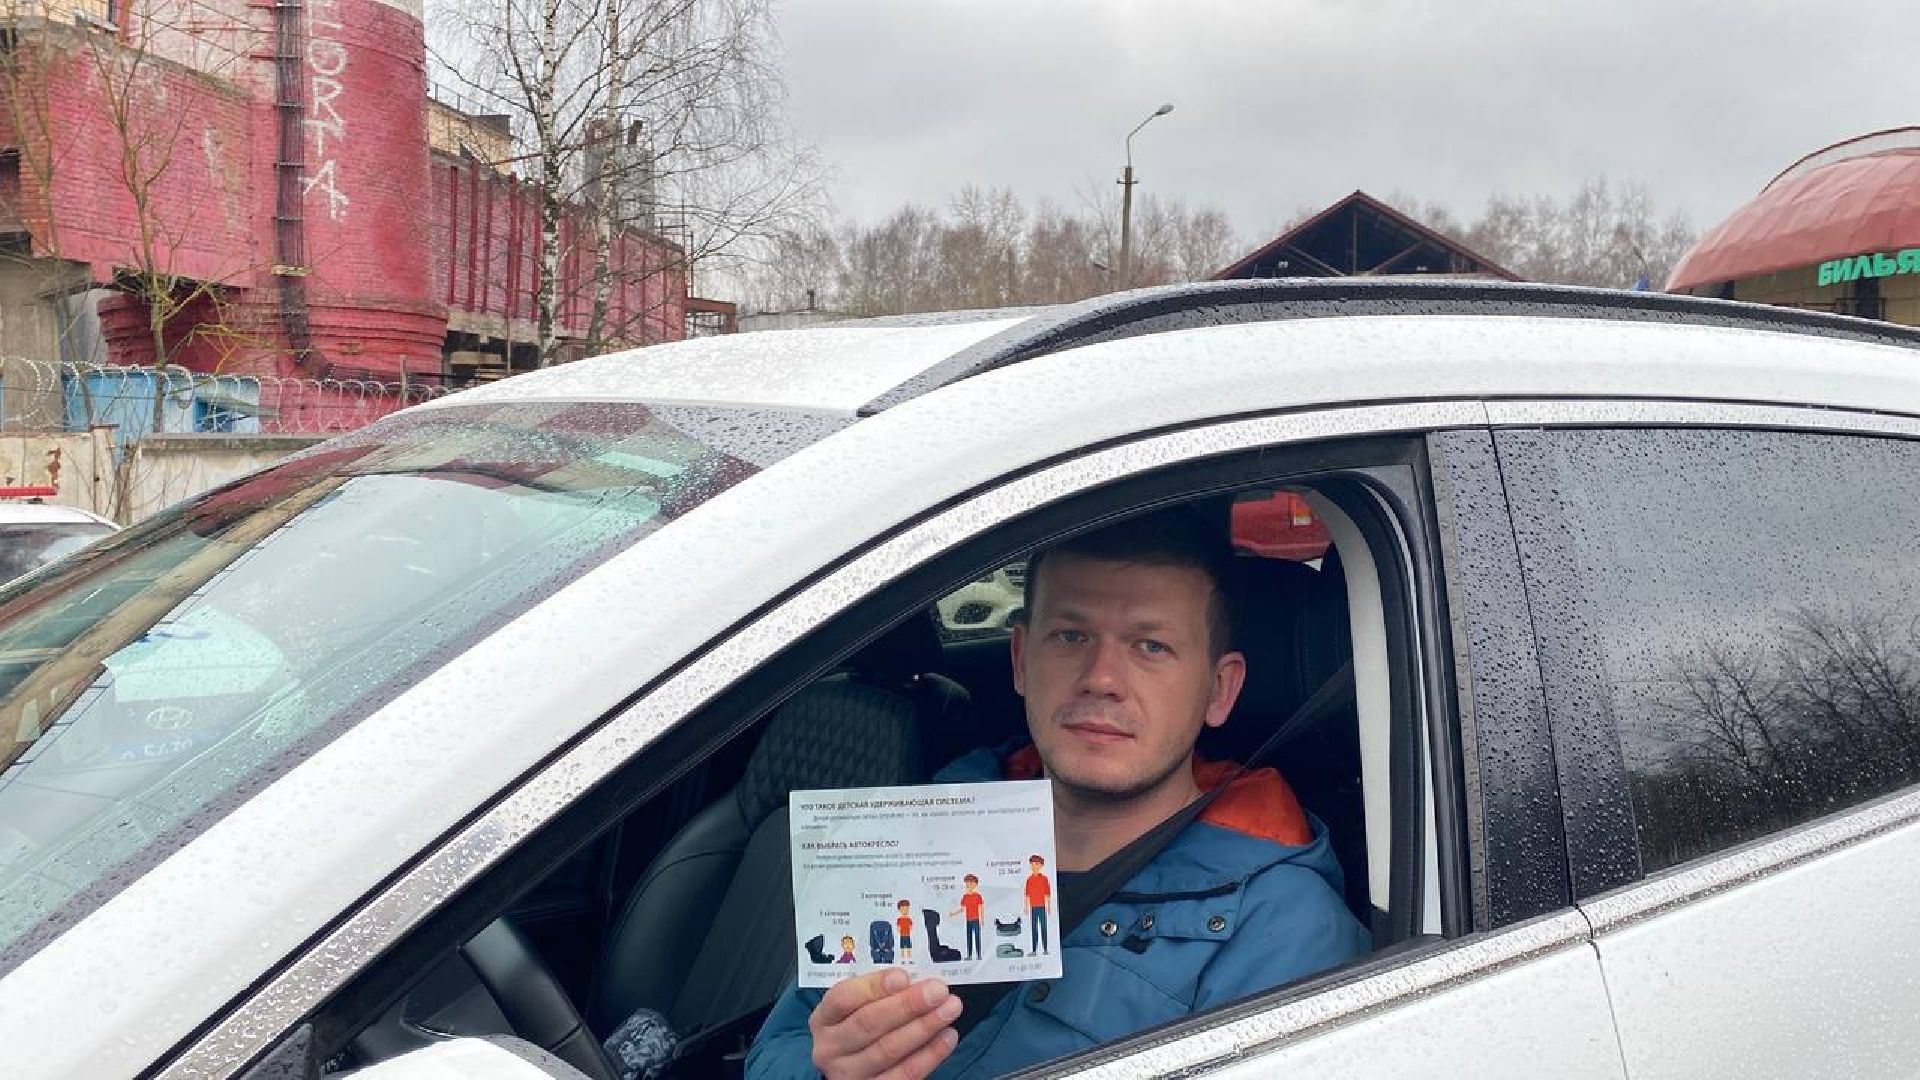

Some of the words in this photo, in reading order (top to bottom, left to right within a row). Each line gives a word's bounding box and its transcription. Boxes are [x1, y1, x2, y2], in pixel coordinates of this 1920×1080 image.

[815, 803, 835, 811] ТАКОЕ
[838, 801, 868, 811] ДЕТСКАЯ
[870, 799, 934, 808] УДЕРЖИВАЮЩАЯ
[816, 841, 847, 849] ВЫБРАТЬ
